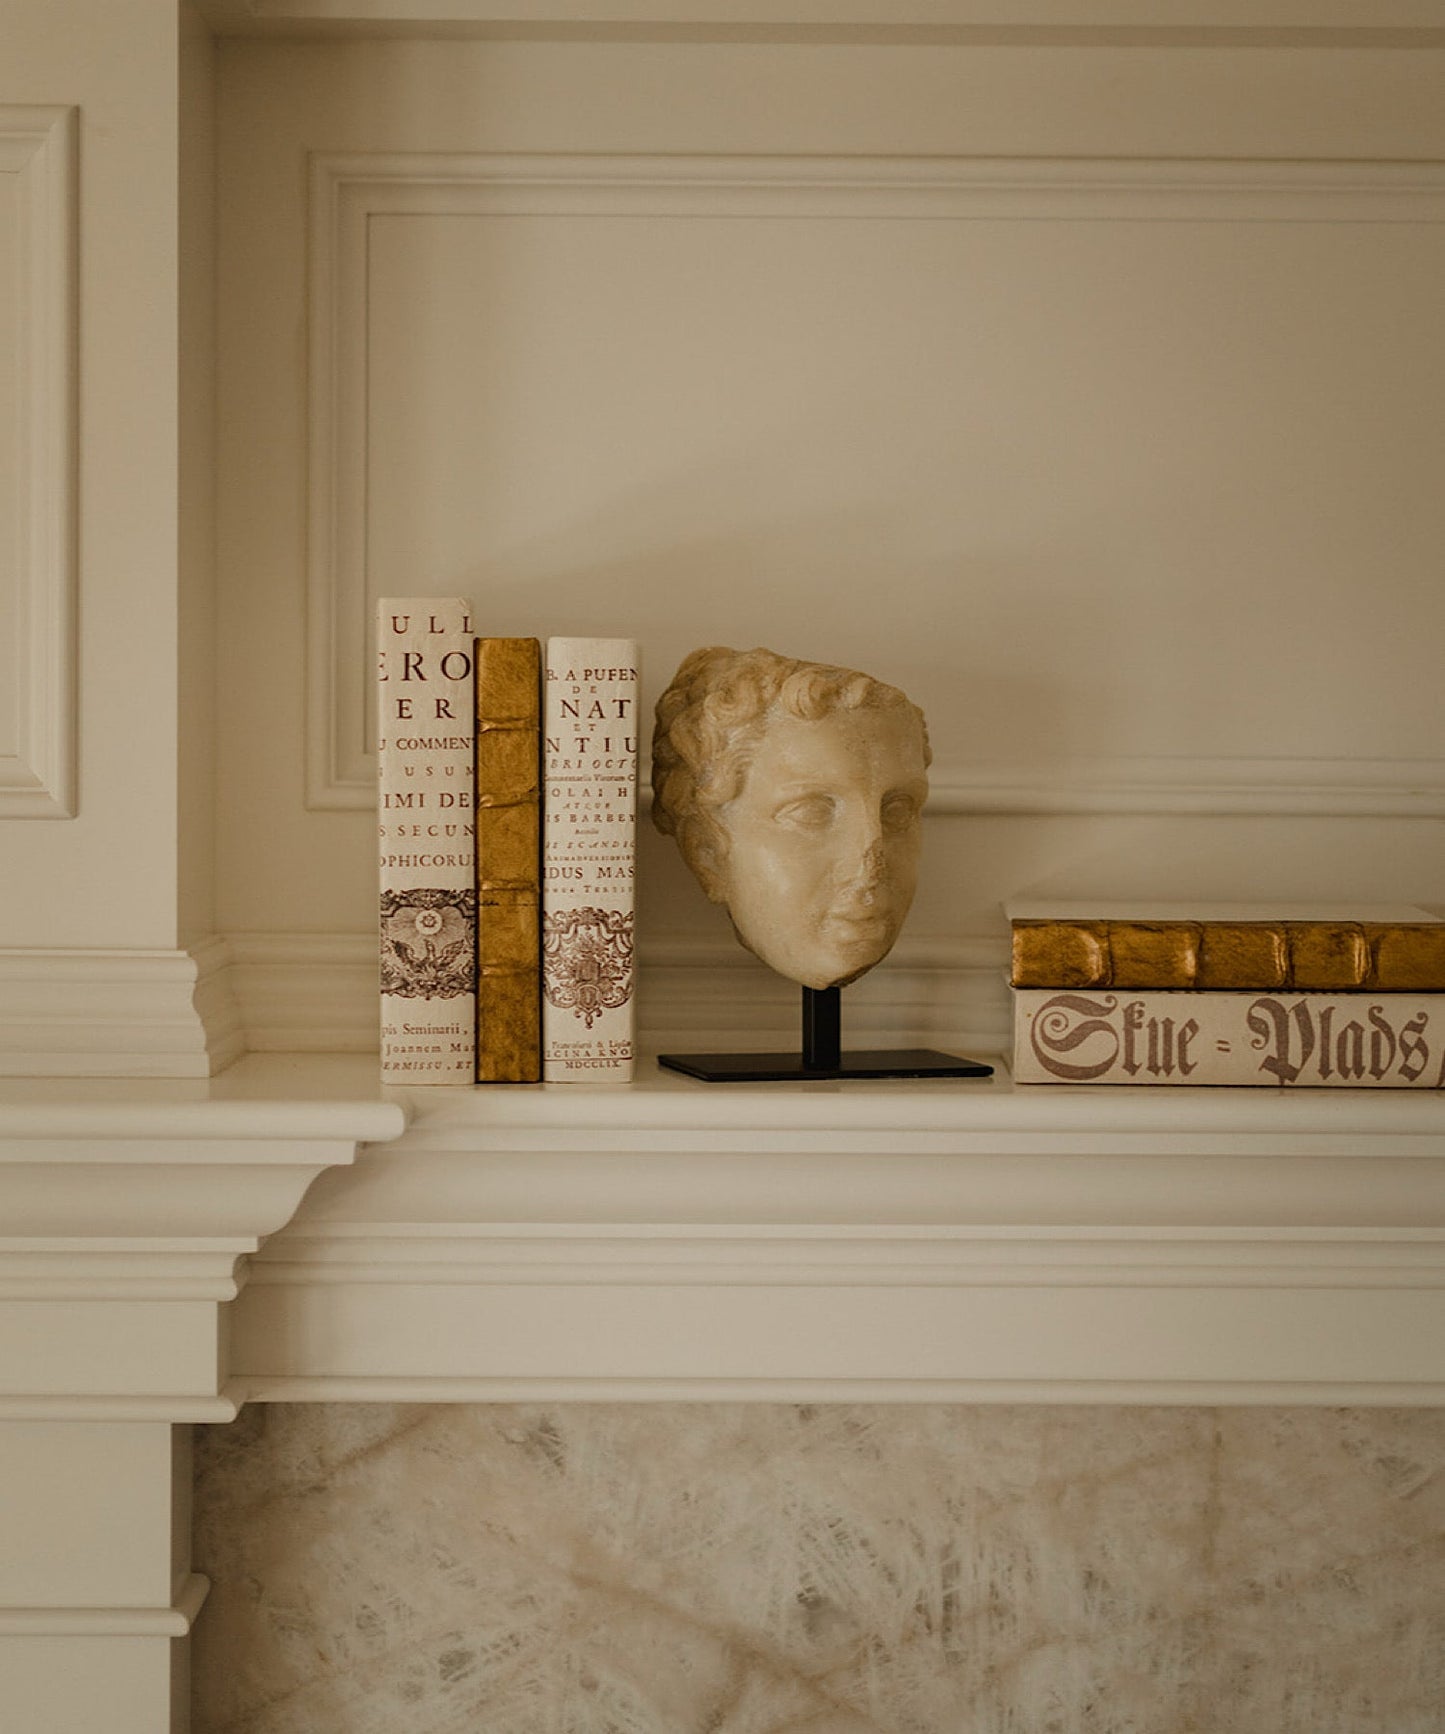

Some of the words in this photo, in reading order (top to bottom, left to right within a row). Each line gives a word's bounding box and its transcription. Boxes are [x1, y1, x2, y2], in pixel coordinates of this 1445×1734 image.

[565, 669, 577, 681] A
[396, 698, 456, 719] ER
[560, 699, 632, 719] NAT
[439, 792, 470, 808] DE
[1031, 994, 1199, 1080] Skue
[1246, 997, 1429, 1084] Plads
